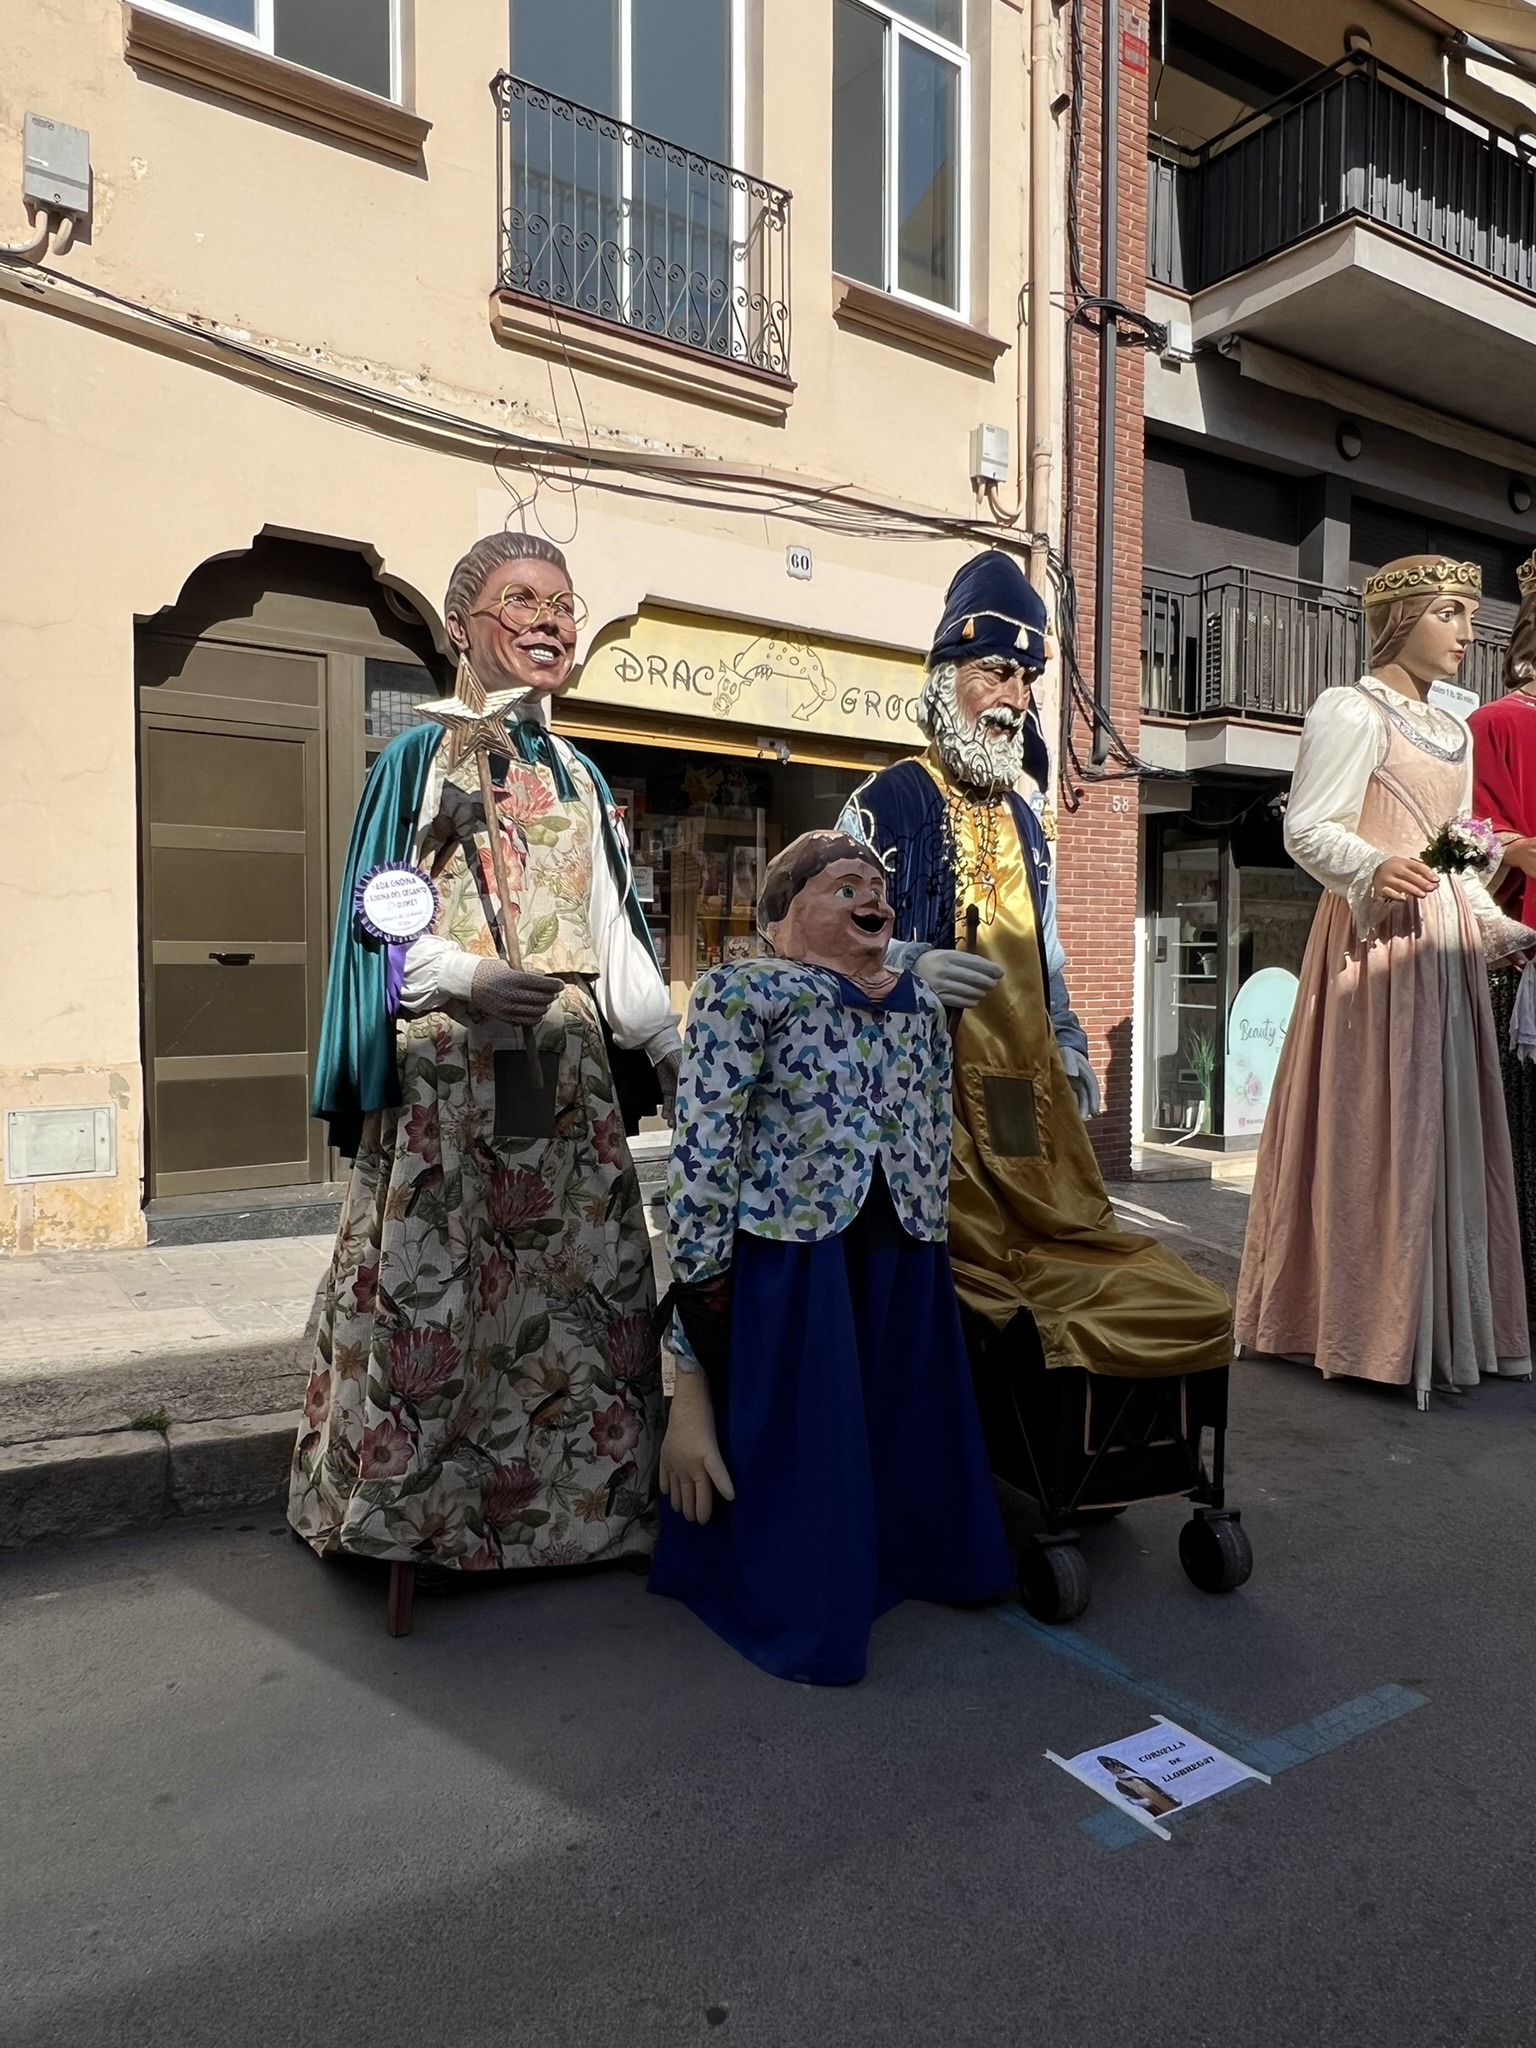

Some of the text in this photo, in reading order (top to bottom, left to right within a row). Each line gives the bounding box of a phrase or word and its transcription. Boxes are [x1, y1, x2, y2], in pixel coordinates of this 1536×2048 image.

[791, 553, 809, 571] 60
[610, 646, 714, 696] DRAC
[1112, 795, 1130, 813] 58
[1239, 1018, 1277, 1047] Beauty
[1161, 1756, 1216, 1783] LLOBREGAT
[1168, 1757, 1182, 1766] DE
